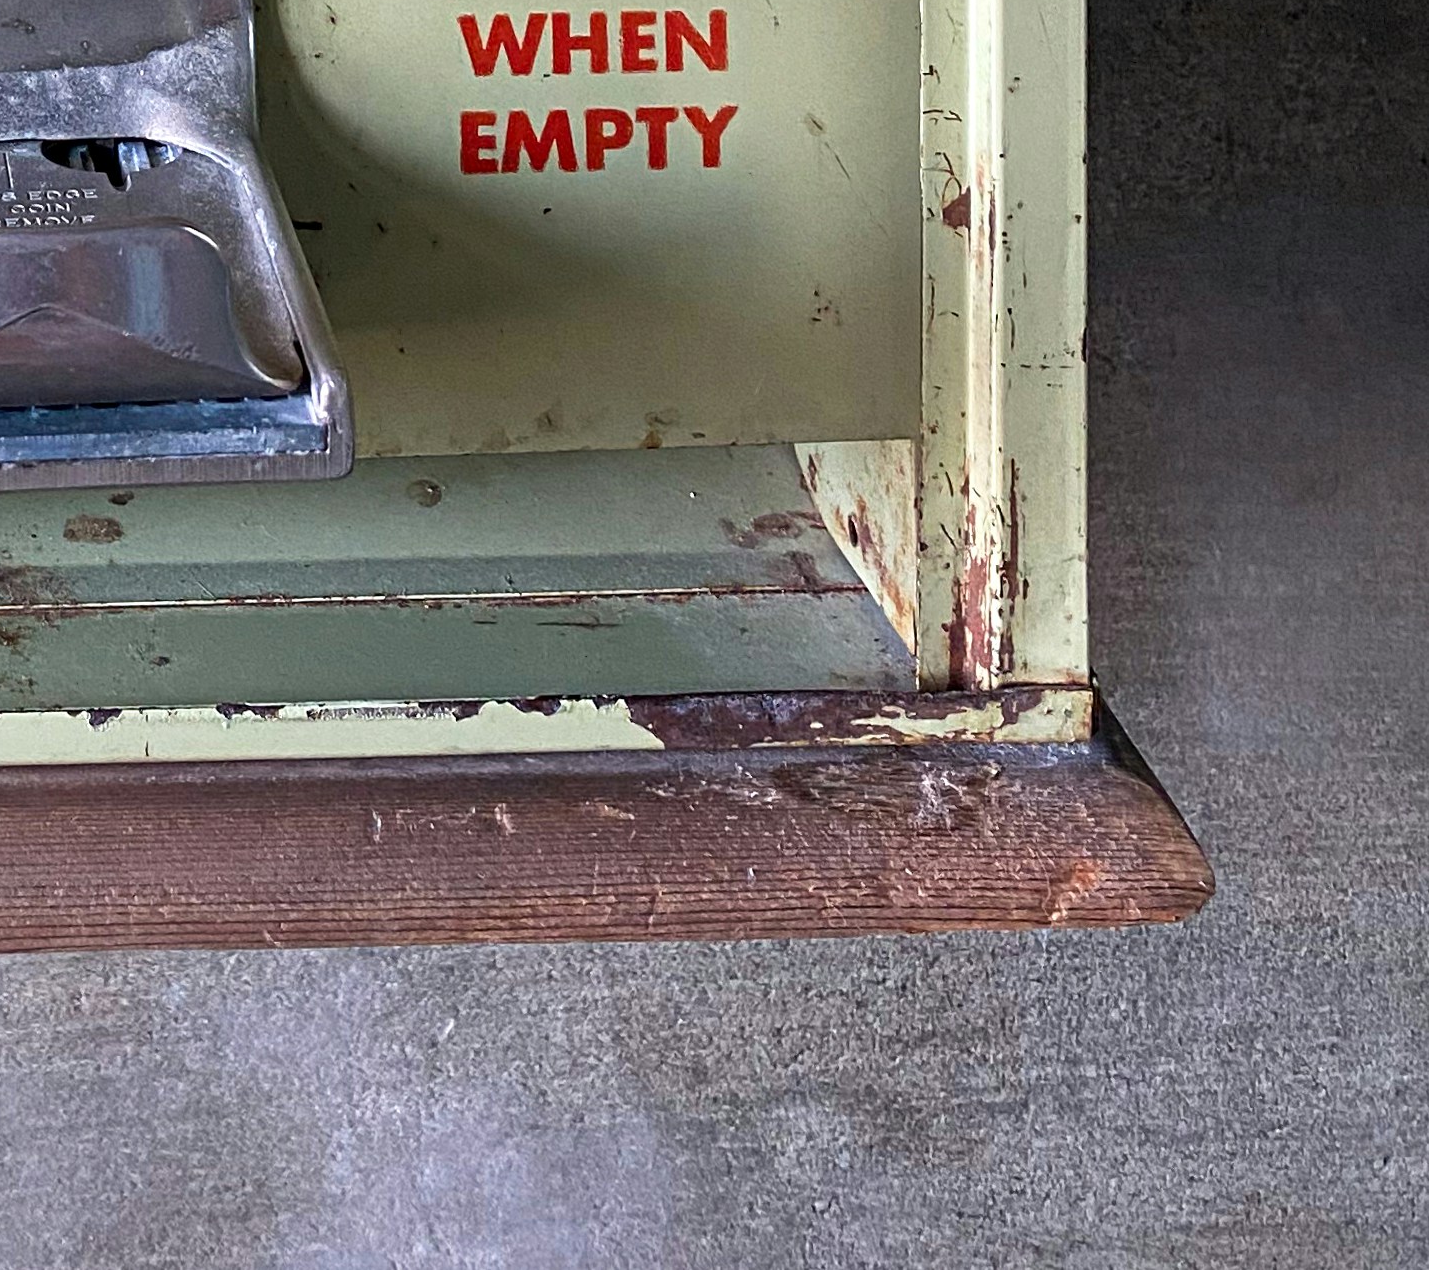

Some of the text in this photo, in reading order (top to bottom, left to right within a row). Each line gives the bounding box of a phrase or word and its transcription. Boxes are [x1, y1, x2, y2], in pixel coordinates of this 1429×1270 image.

[457, 8, 729, 77] WHEN
[460, 104, 739, 175] EMPTY
[10, 202, 71, 214] COIN
[27, 188, 98, 201] EDGE
